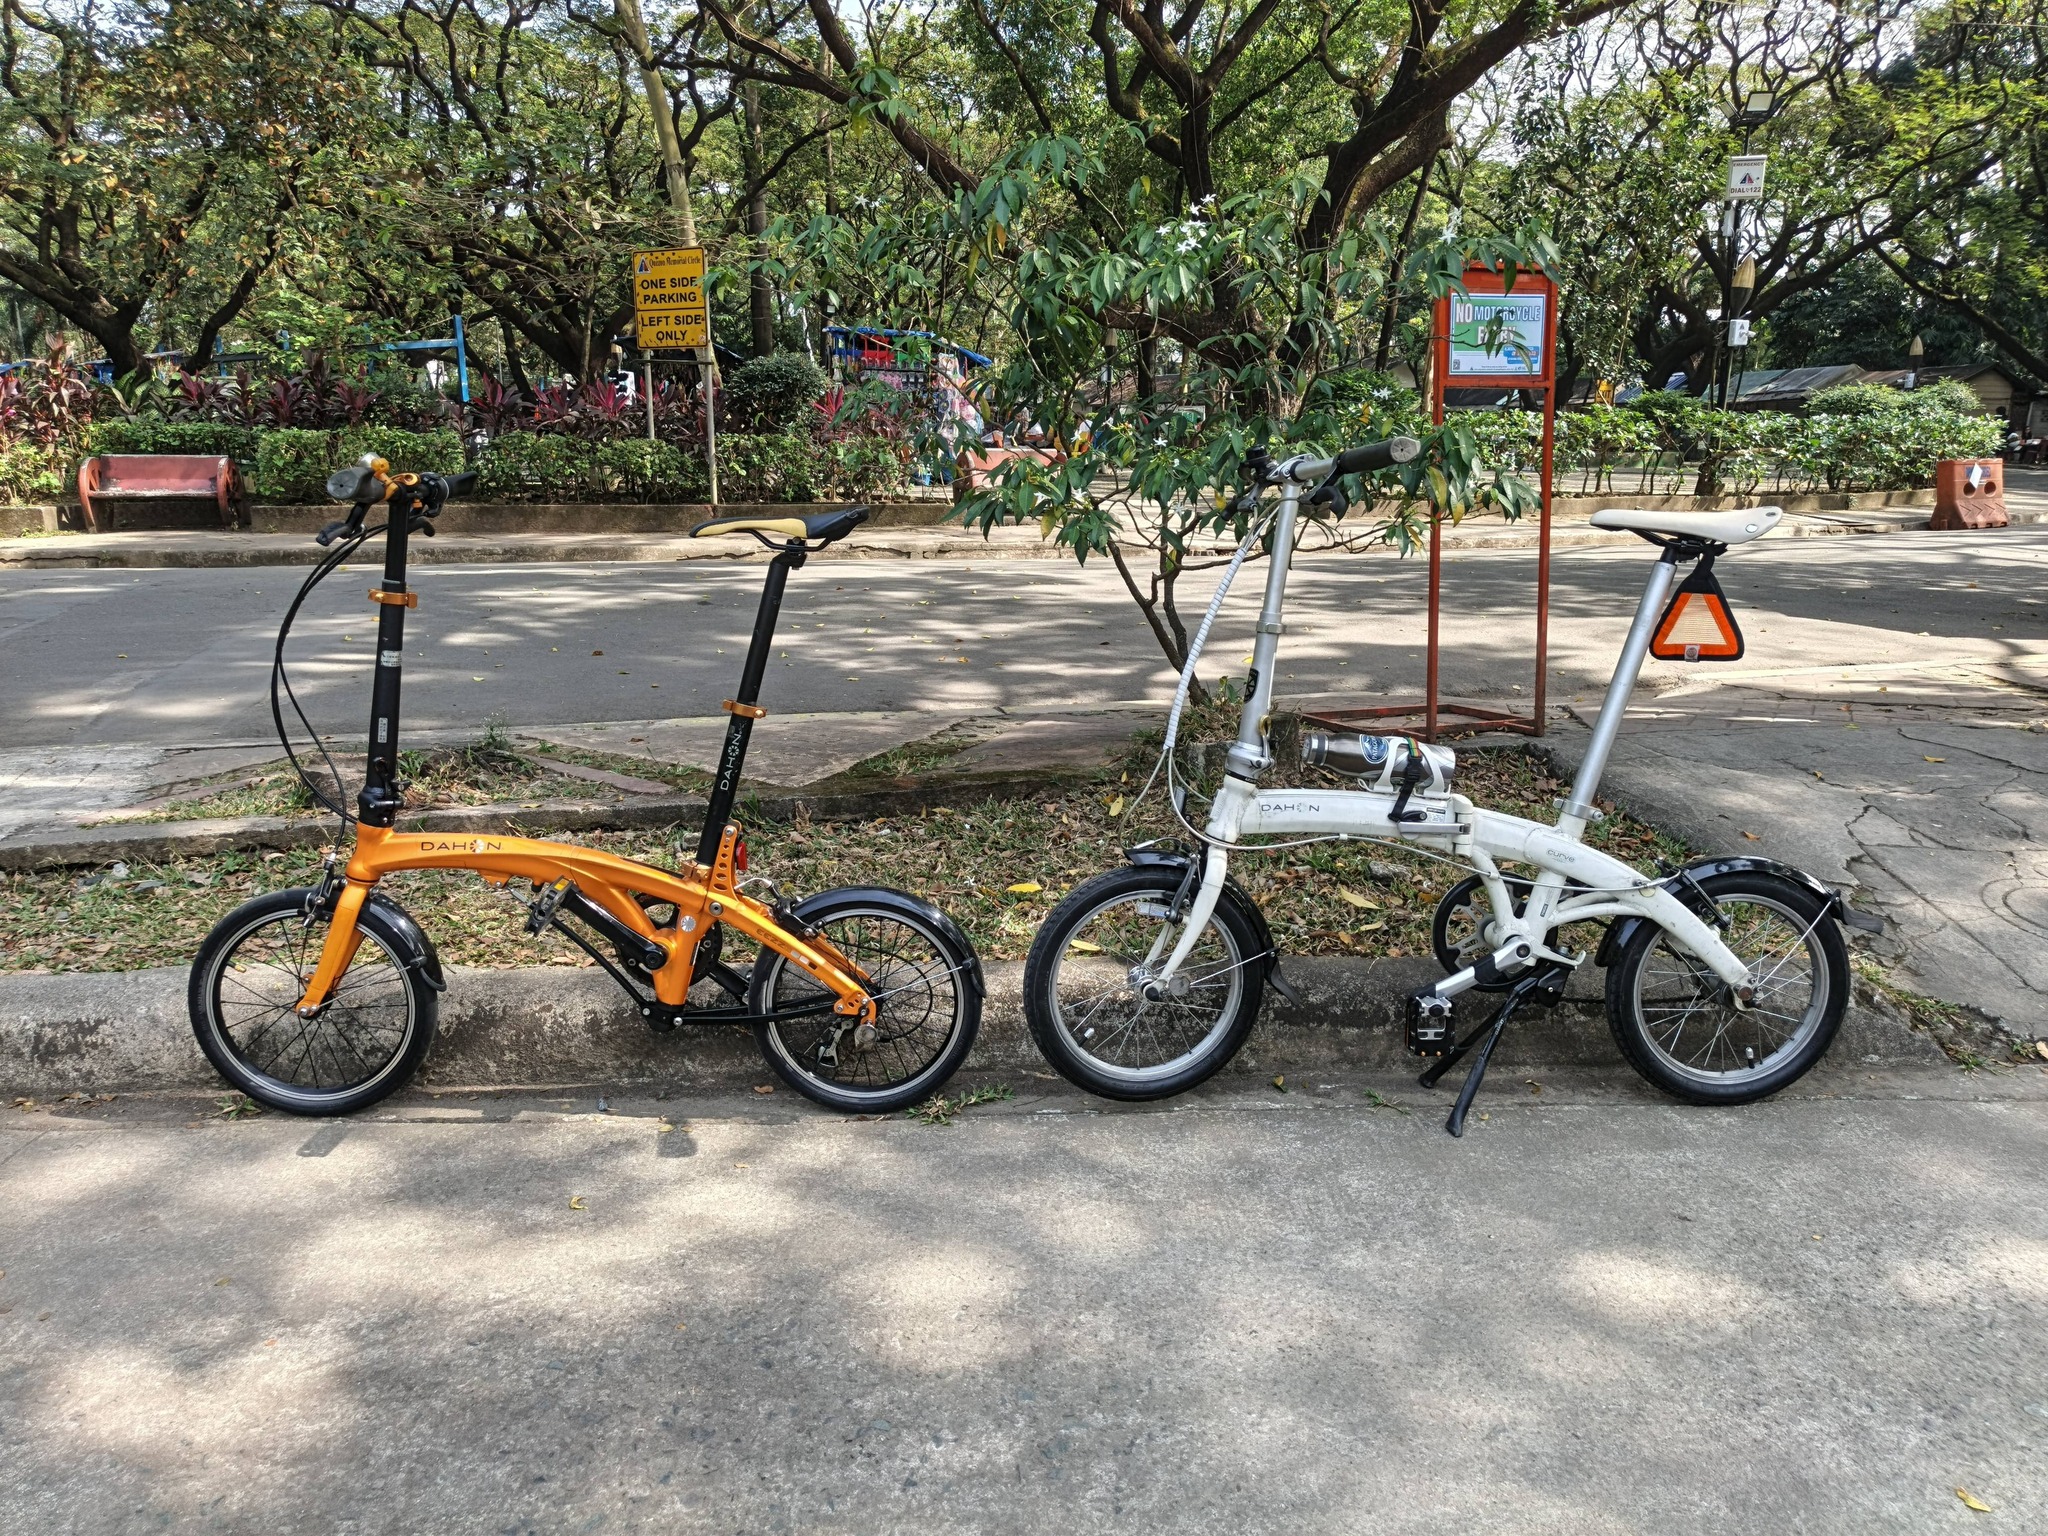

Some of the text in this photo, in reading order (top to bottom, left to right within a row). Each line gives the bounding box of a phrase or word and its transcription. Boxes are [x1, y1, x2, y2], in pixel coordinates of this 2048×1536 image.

[641, 276, 698, 290] ONE SIDE
[643, 291, 697, 304] PARKING
[1455, 302, 1473, 323] NO
[641, 314, 702, 327] LEFT SIDE
[656, 330, 687, 341] ONLY
[720, 732, 742, 791] DAHON
[1261, 802, 1320, 813] DAHON
[421, 838, 502, 854] DAHON
